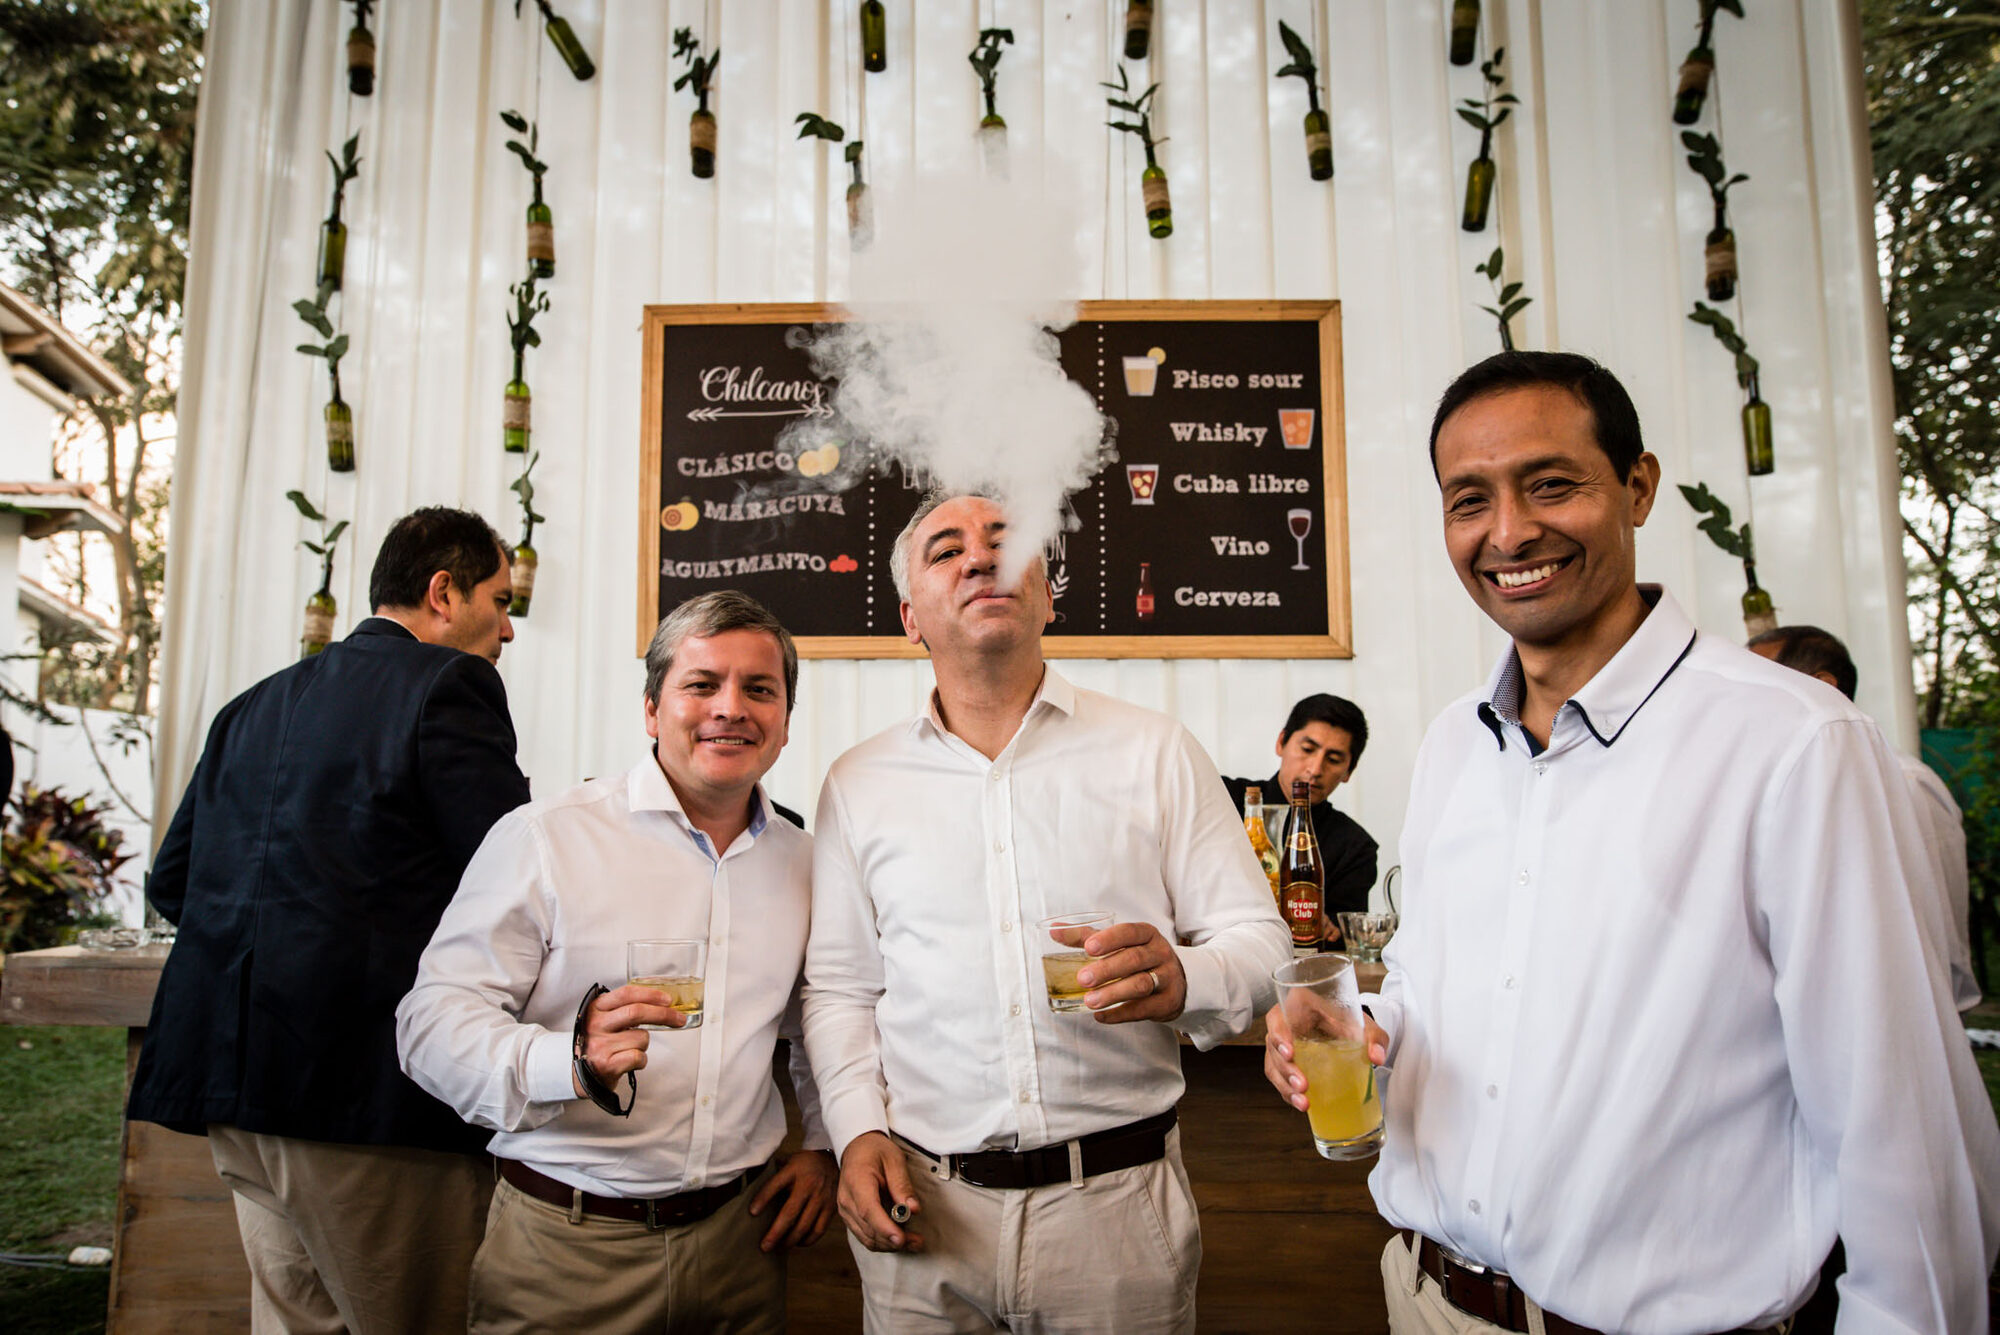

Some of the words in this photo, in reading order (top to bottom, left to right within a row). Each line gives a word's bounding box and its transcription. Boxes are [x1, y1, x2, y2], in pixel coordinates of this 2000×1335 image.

[699, 366, 825, 408] Chilcanos
[1172, 369, 1239, 389] Pisco
[1248, 373, 1303, 389] sour
[1170, 422, 1268, 447] Whisky
[677, 451, 795, 478] CLÁSICO
[1173, 474, 1239, 494] Cuba
[1249, 474, 1310, 494] libre
[1210, 536, 1270, 556] Vino
[660, 552, 827, 579] AGUAYMANTO
[1174, 587, 1281, 607] Cerveza
[1287, 900, 1318, 909] Havana
[1294, 909, 1312, 918] Club
